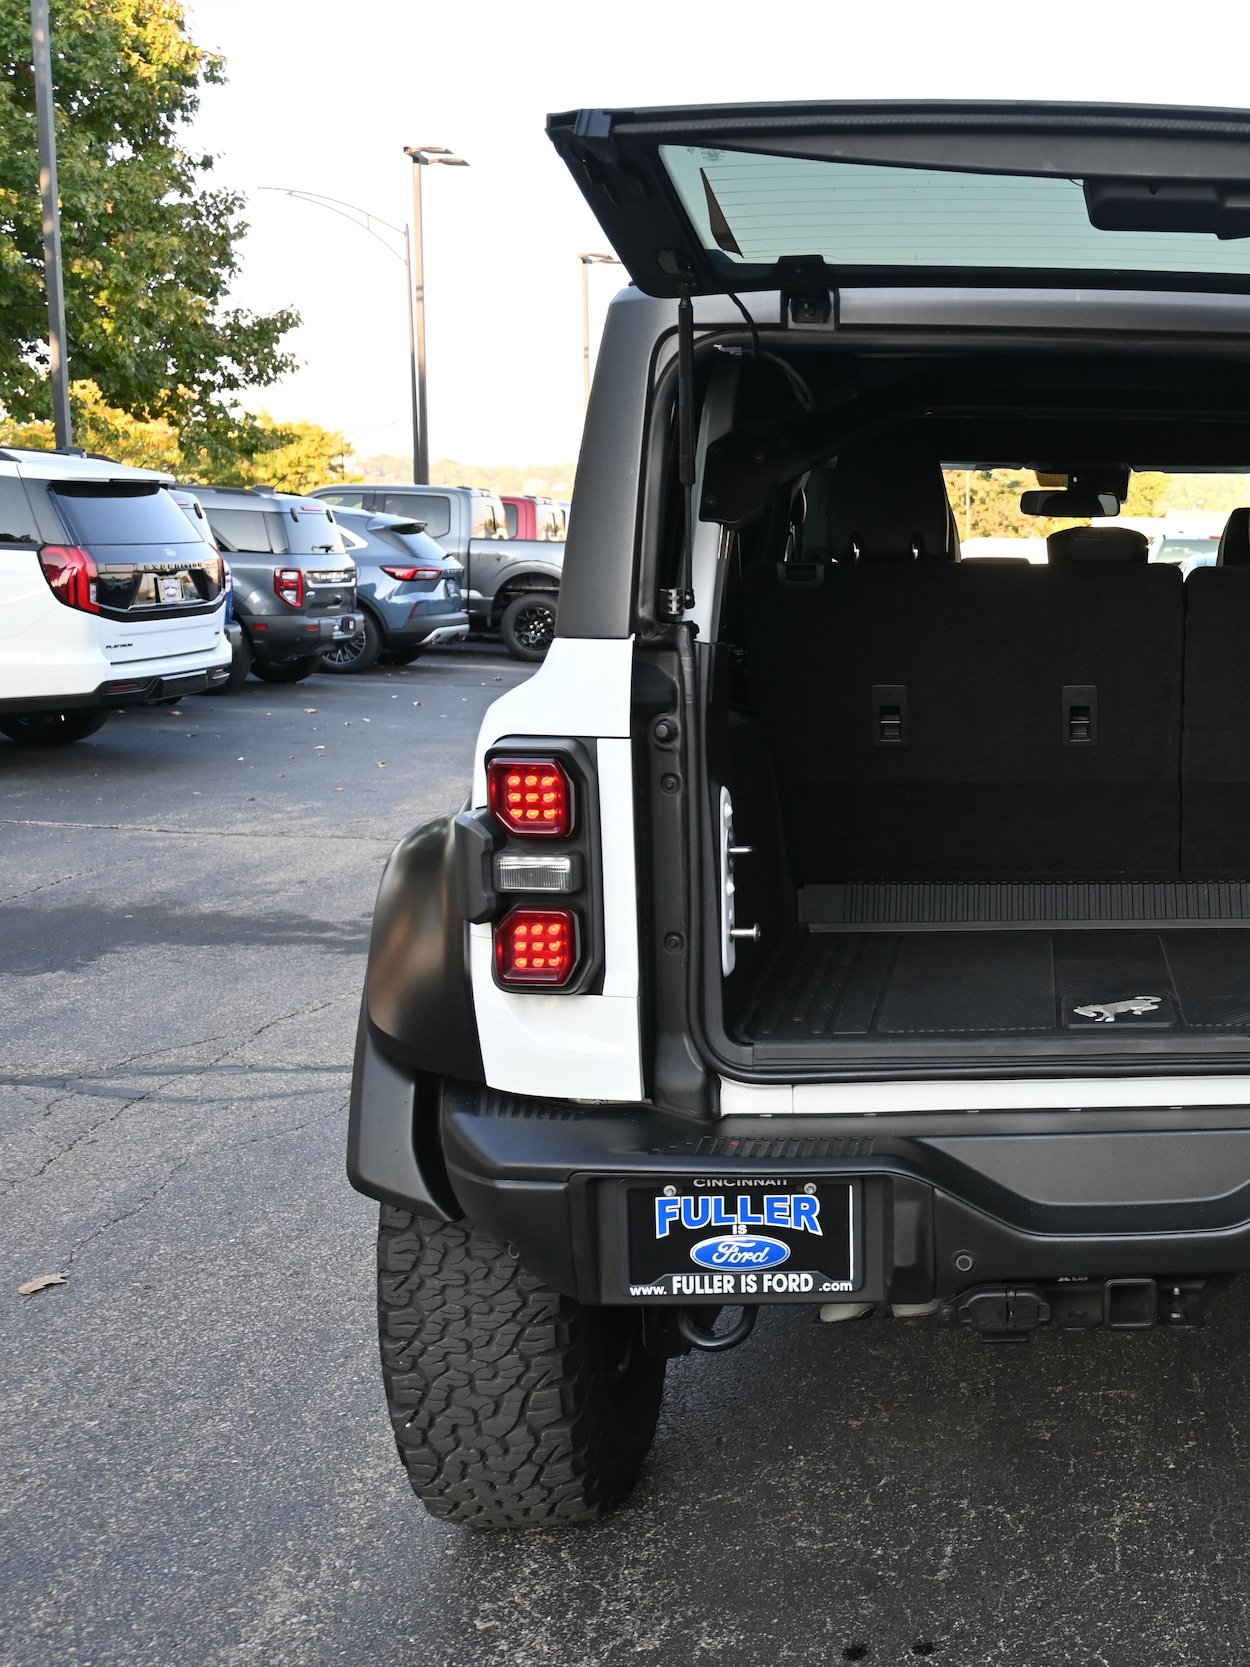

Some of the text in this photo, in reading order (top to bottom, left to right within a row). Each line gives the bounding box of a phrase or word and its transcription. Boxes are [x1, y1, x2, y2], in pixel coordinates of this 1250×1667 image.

[655, 1194, 823, 1239] FULLER
[732, 1225, 748, 1235] IS
[712, 1240, 770, 1264] Ford
[629, 1273, 853, 1296] www. FULLER IS FORD .com
